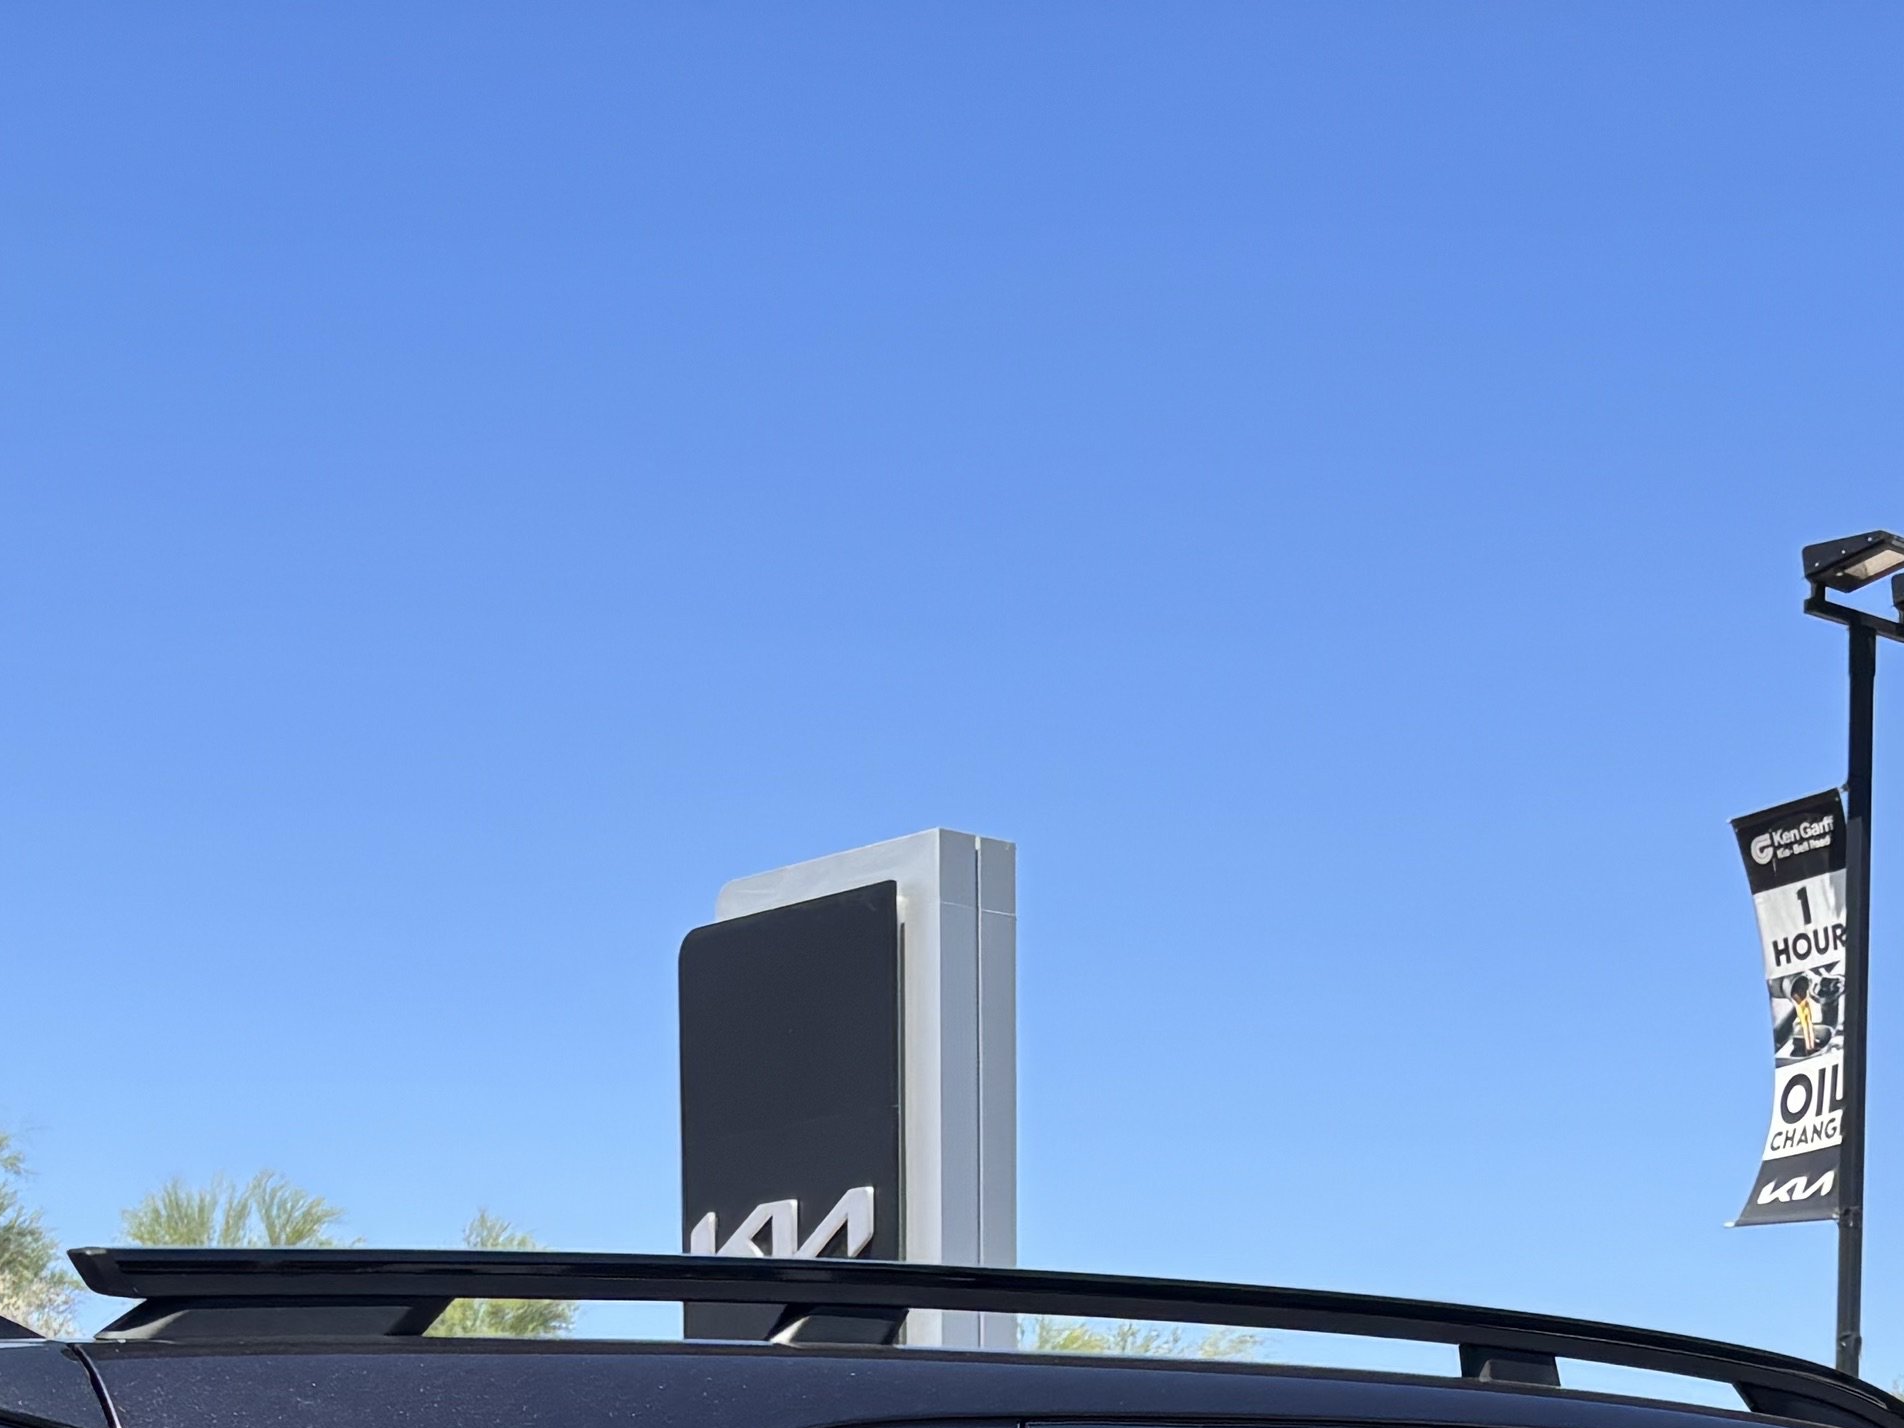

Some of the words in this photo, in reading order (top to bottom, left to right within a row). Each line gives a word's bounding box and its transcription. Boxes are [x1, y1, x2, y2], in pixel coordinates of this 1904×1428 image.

[1772, 828, 1800, 846] Ken
[1799, 814, 1834, 838] Garff
[1796, 886, 1812, 925] 1
[1772, 923, 1847, 967] HOUR
[1780, 1064, 1842, 1124] OIL
[1770, 1117, 1839, 1151] CHANG
